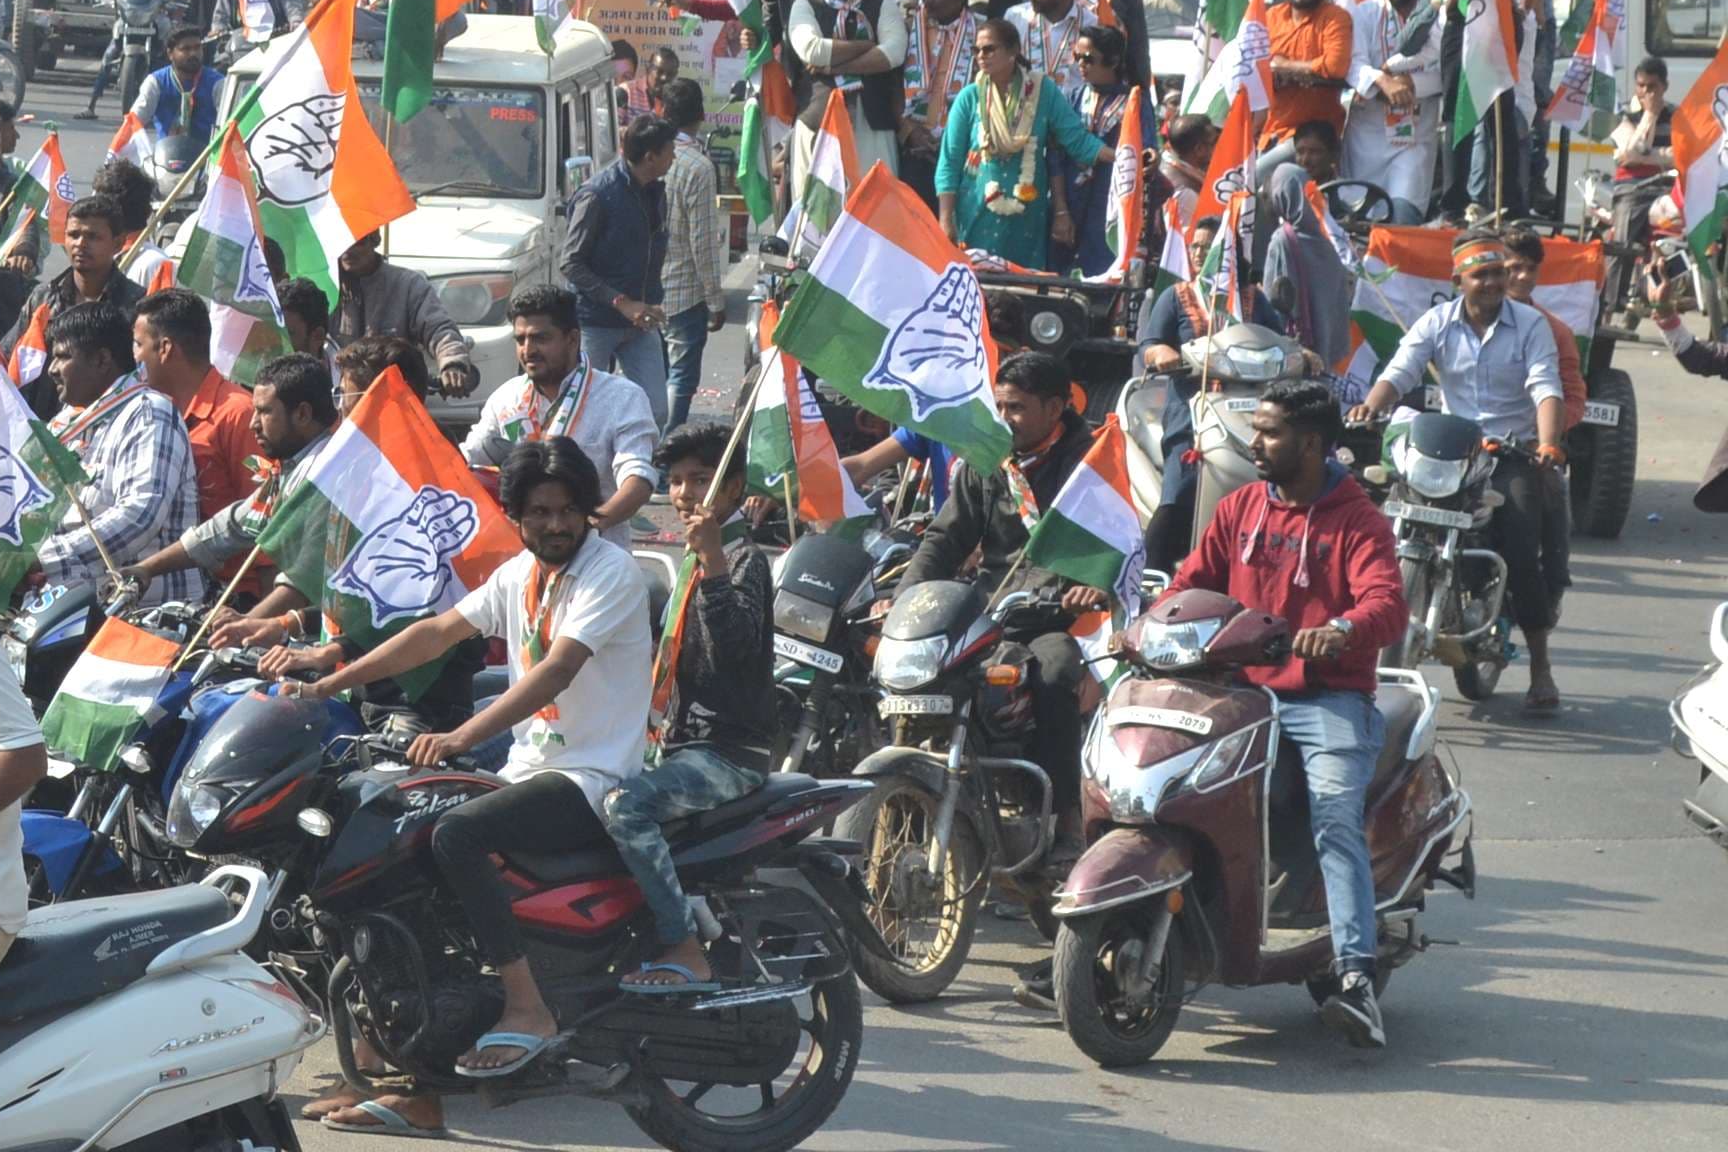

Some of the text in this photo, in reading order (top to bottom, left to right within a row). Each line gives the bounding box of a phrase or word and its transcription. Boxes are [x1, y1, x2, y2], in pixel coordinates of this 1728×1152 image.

[490, 107, 536, 122] PRESS
[1178, 715, 1206, 729] 2079
[393, 793, 470, 834] Pulsar
[130, 920, 163, 934] HONDA
[129, 931, 155, 944] AJMER
